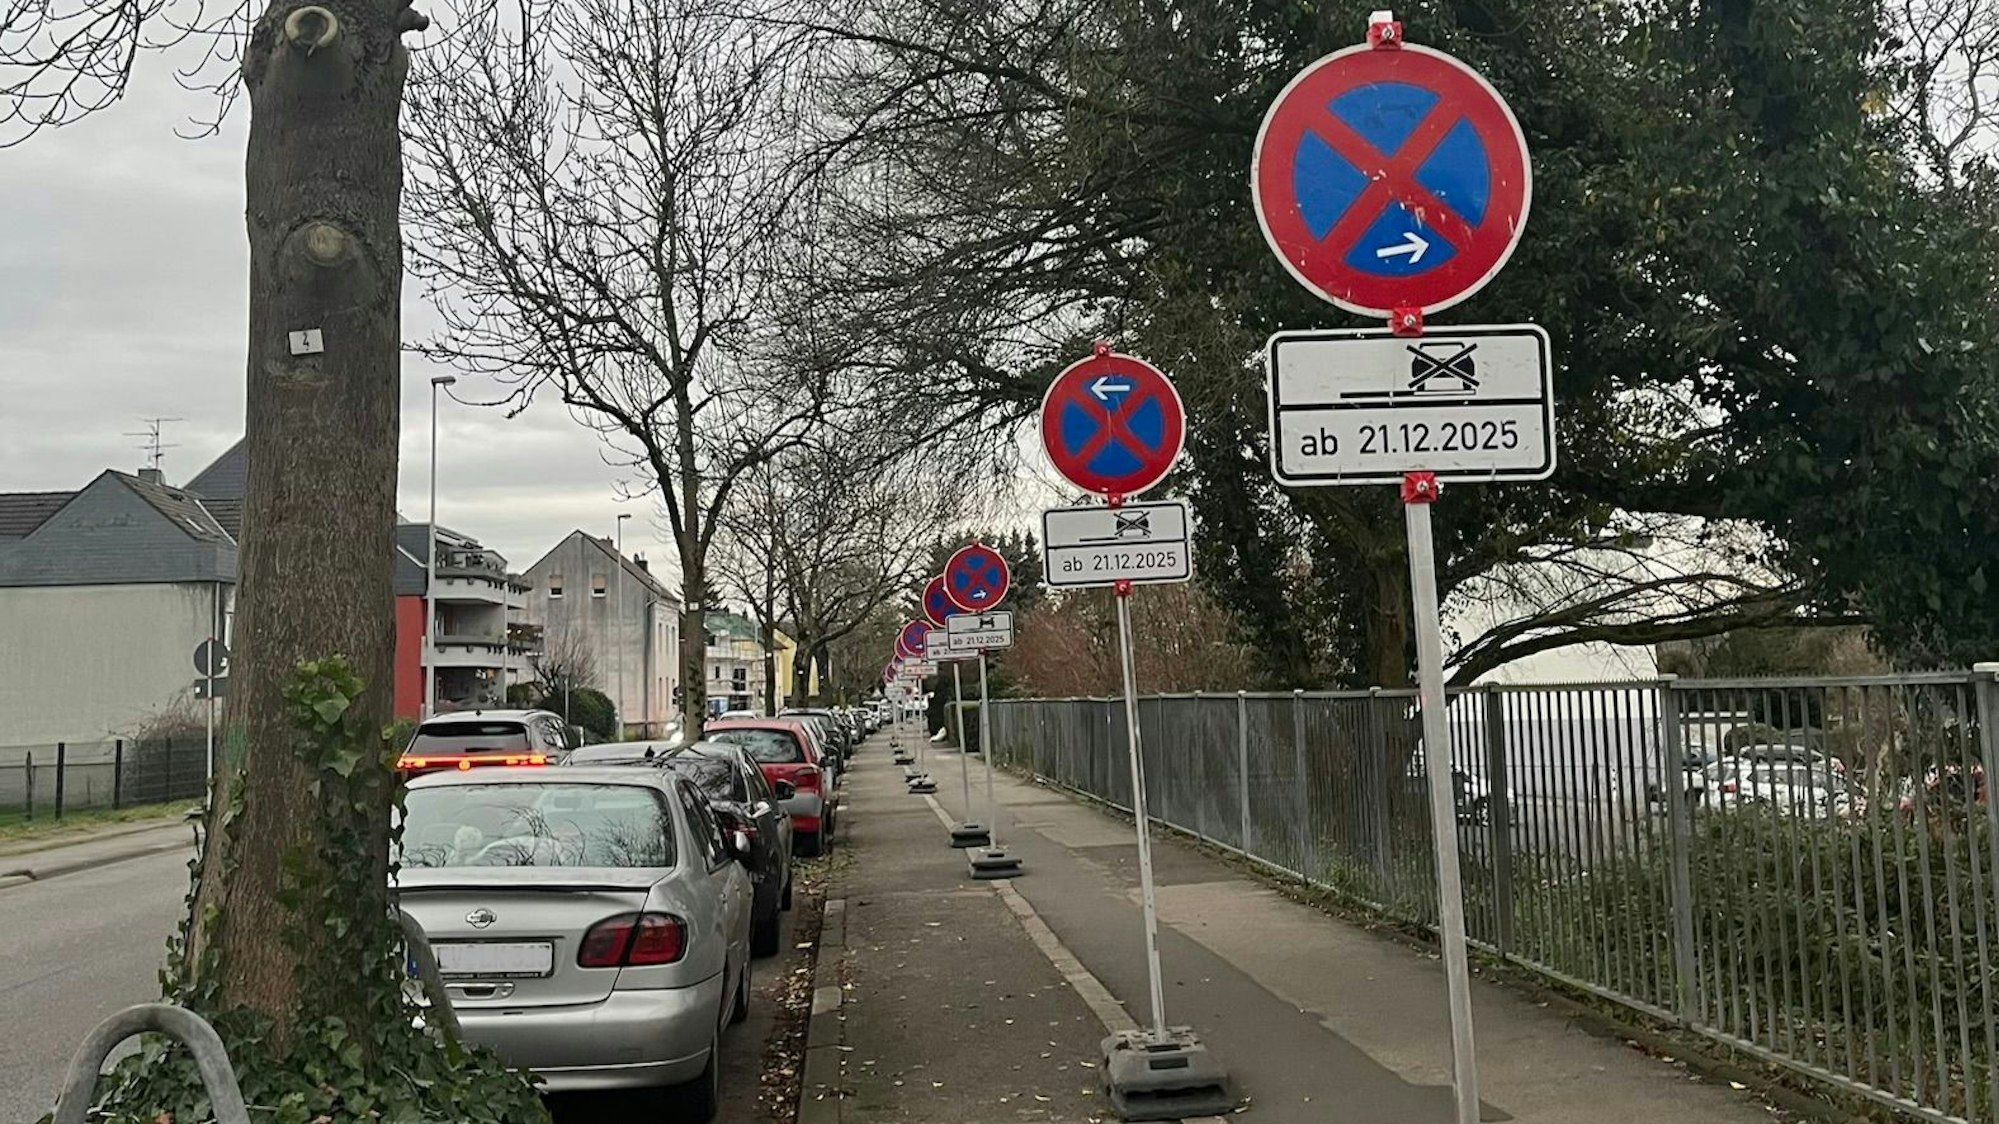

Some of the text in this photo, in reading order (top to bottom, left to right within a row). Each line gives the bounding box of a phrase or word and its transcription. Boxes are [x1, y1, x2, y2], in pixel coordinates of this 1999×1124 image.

[1300, 420, 1519, 456] ab 21.12.2025
[1063, 551, 1176, 572] ab 21.12.2025
[953, 634, 1005, 645] ab 21.12.2025
